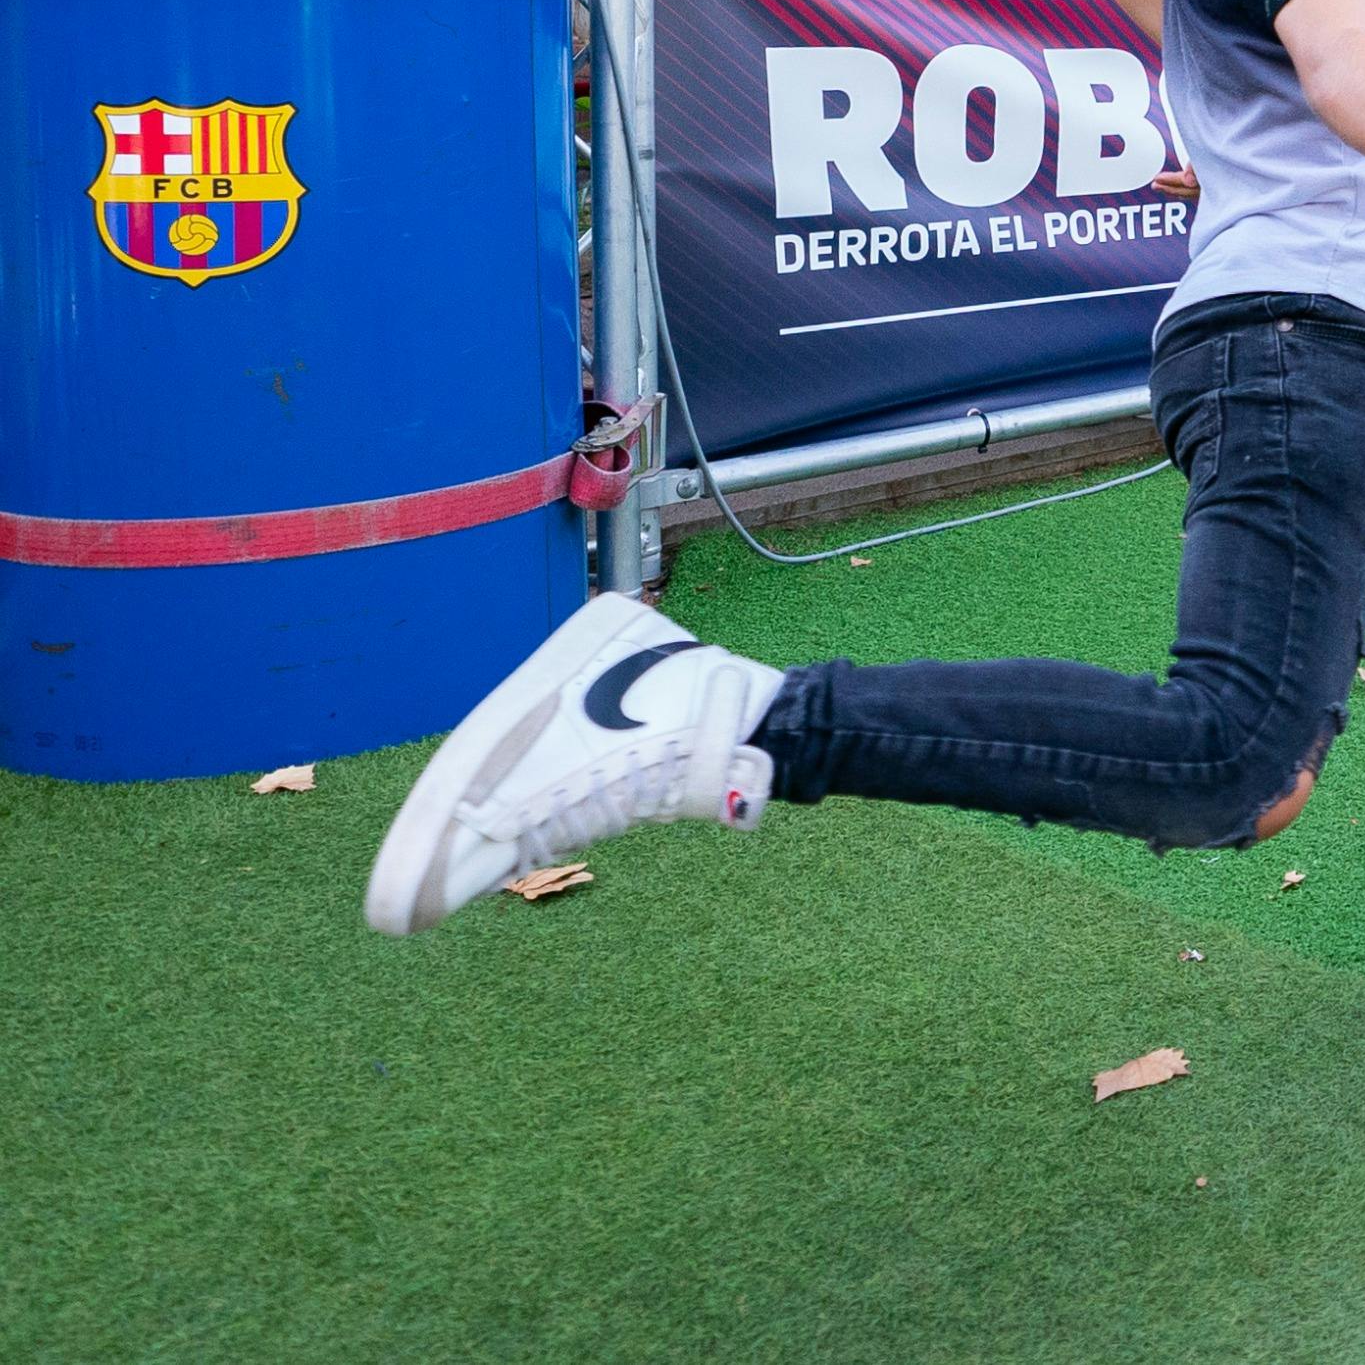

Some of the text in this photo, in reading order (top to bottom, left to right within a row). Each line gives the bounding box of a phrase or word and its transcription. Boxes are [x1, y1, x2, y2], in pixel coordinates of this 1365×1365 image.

[154, 178, 233, 199] FCB
[775, 220, 981, 274] DERROTA
[989, 215, 1037, 253] EL
[1044, 202, 1187, 247] PORTER
